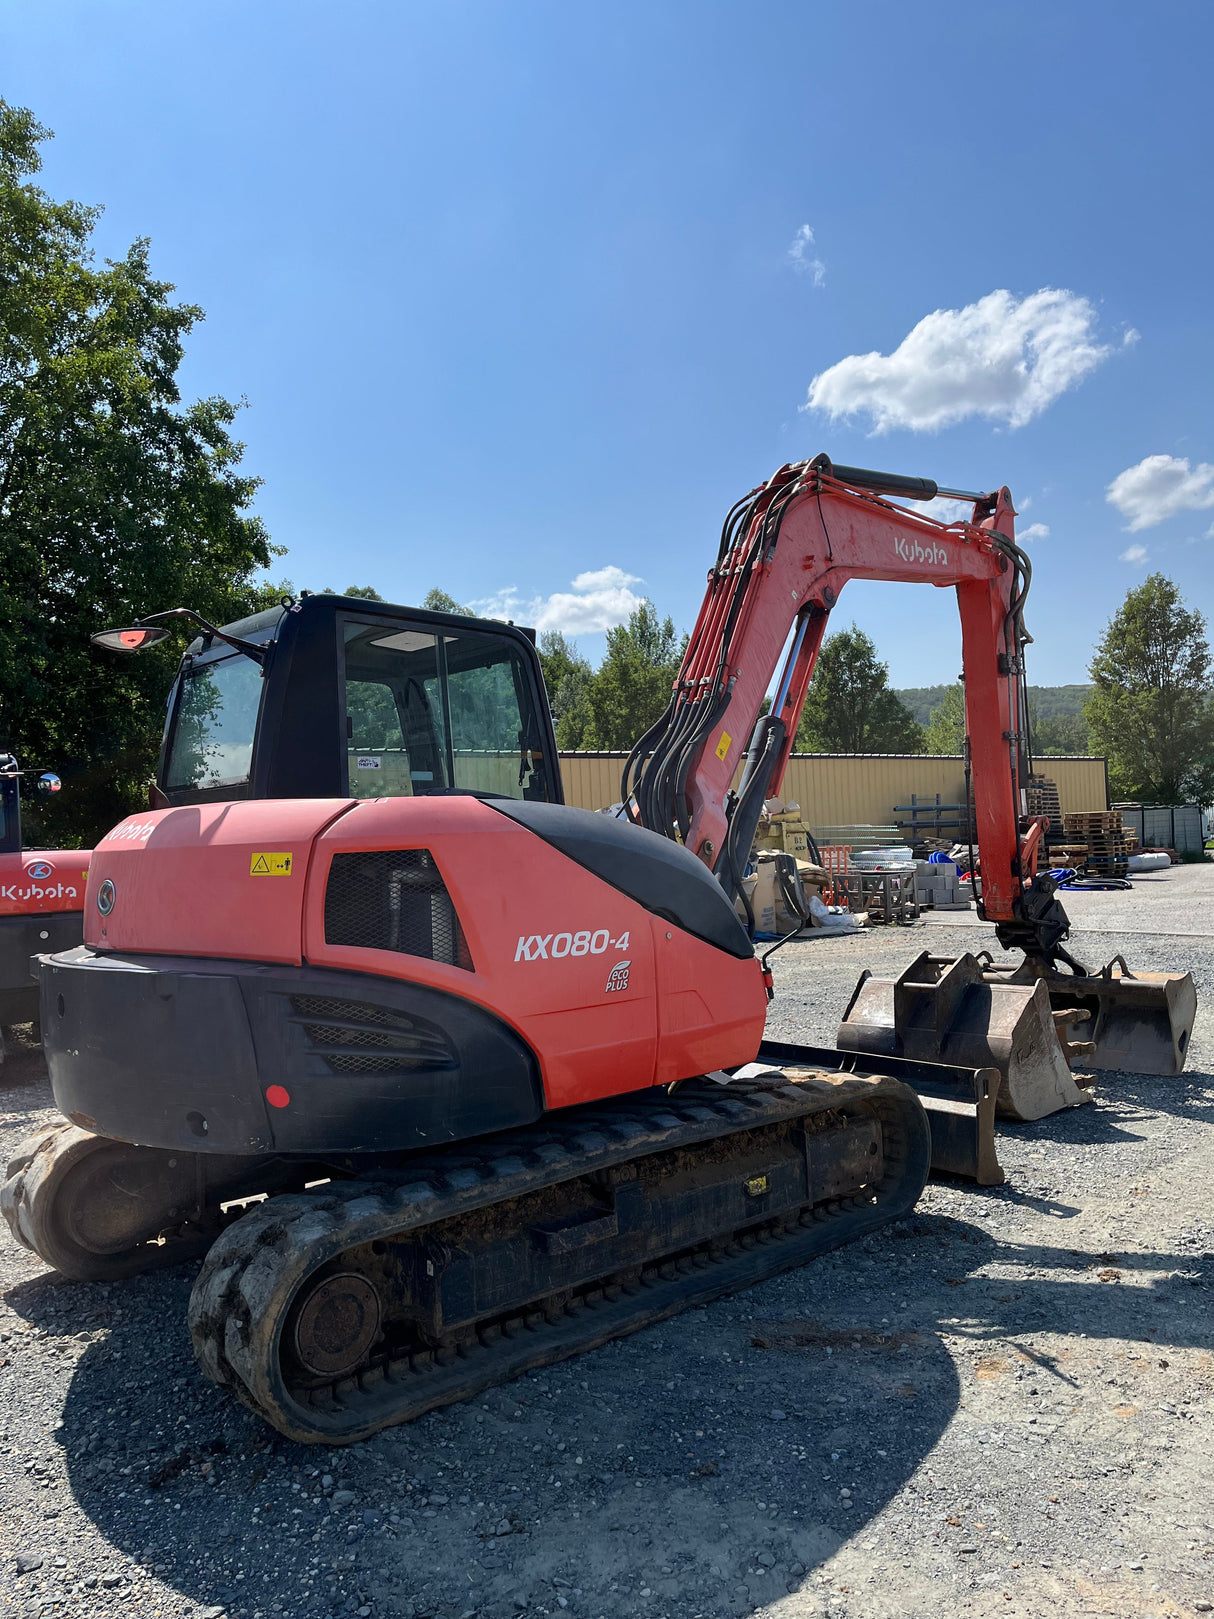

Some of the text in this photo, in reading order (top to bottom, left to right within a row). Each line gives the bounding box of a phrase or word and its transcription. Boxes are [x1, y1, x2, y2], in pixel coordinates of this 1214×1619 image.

[894, 537, 948, 566] Kubota
[1, 883, 77, 901] Kubota
[514, 929, 630, 962] KX080-4
[611, 969, 630, 981] eco
[605, 979, 629, 993] PLUS
